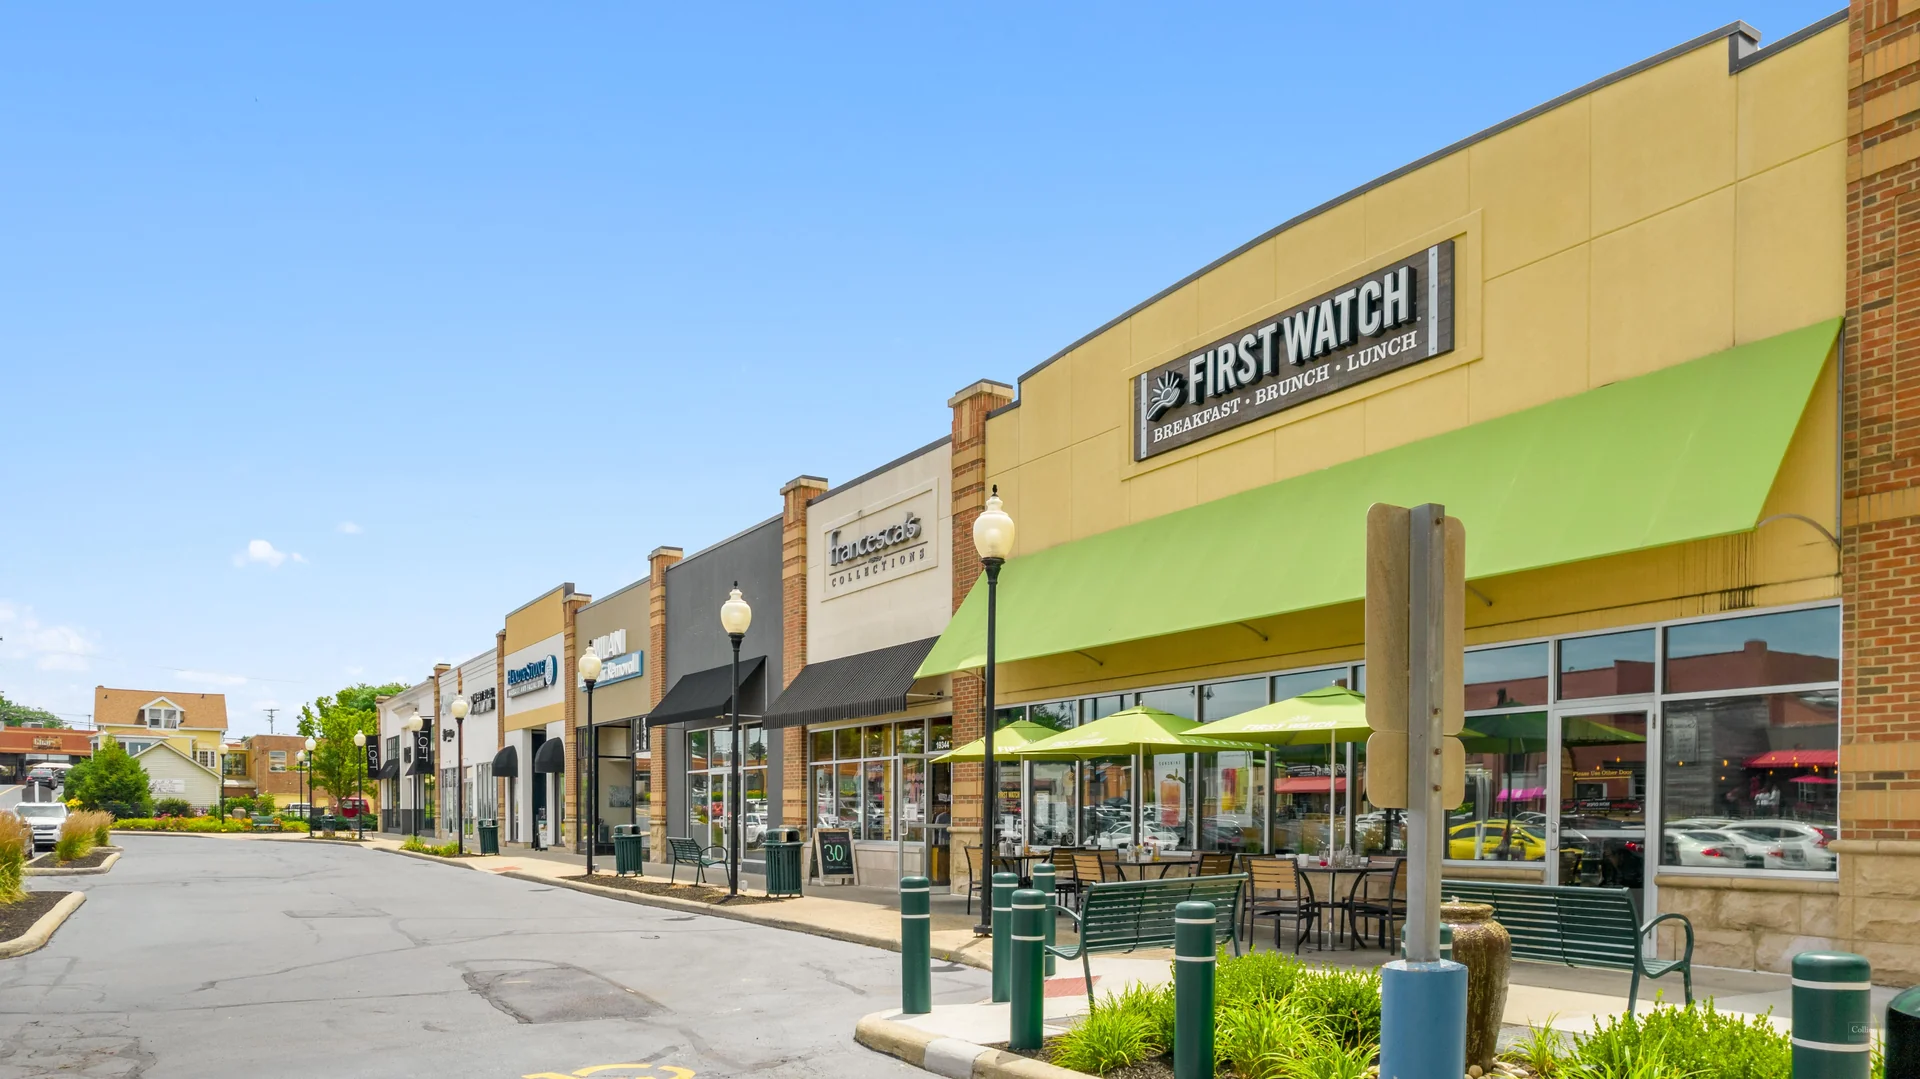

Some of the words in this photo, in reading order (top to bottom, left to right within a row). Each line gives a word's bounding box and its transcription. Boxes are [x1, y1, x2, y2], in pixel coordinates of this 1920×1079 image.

[1188, 321, 1281, 405] FIRST
[1283, 265, 1415, 366] WATCH
[1153, 397, 1241, 443] BREAKFAST
[1255, 364, 1330, 406] BRUNCH
[1347, 330, 1418, 370] LUNCH
[829, 512, 921, 567] francesca's
[831, 548, 926, 588] COLLECTIONS
[607, 653, 639, 680] Removal
[1241, 721, 1285, 731] FIRST
[1287, 720, 1337, 729] WATCH
[367, 744, 379, 770] LOFT
[418, 730, 429, 762] LOFT
